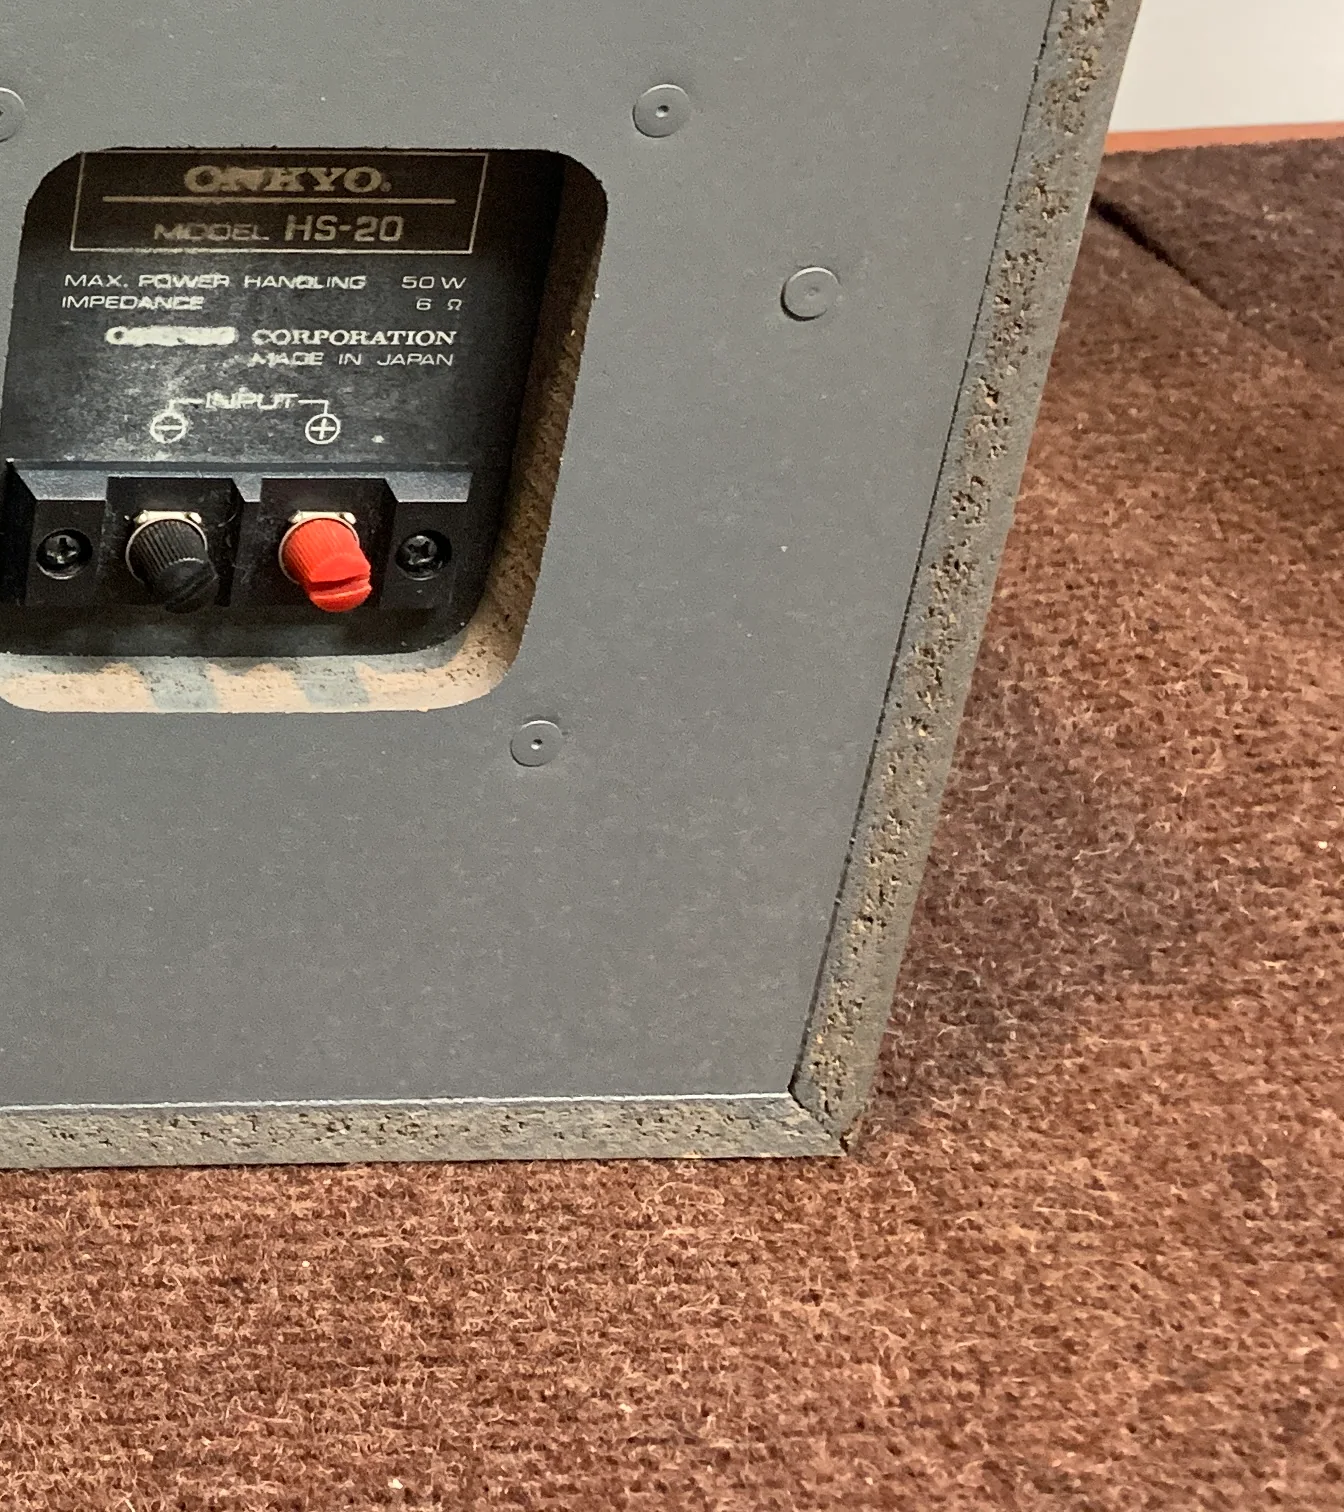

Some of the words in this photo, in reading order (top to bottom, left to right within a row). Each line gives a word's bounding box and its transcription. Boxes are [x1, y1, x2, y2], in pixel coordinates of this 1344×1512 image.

[153, 222, 270, 241] MODEL
[284, 215, 404, 242] HS-20
[64, 274, 129, 288] MAX.
[138, 274, 230, 288] POWER
[244, 274, 367, 289] HANDLING
[61, 295, 204, 310] IMPEDANCE
[251, 329, 456, 347] CORPORATION
[248, 351, 324, 366] MADE
[339, 352, 361, 366] IN
[377, 353, 453, 366] JAPAN
[205, 392, 299, 410] INPUT
